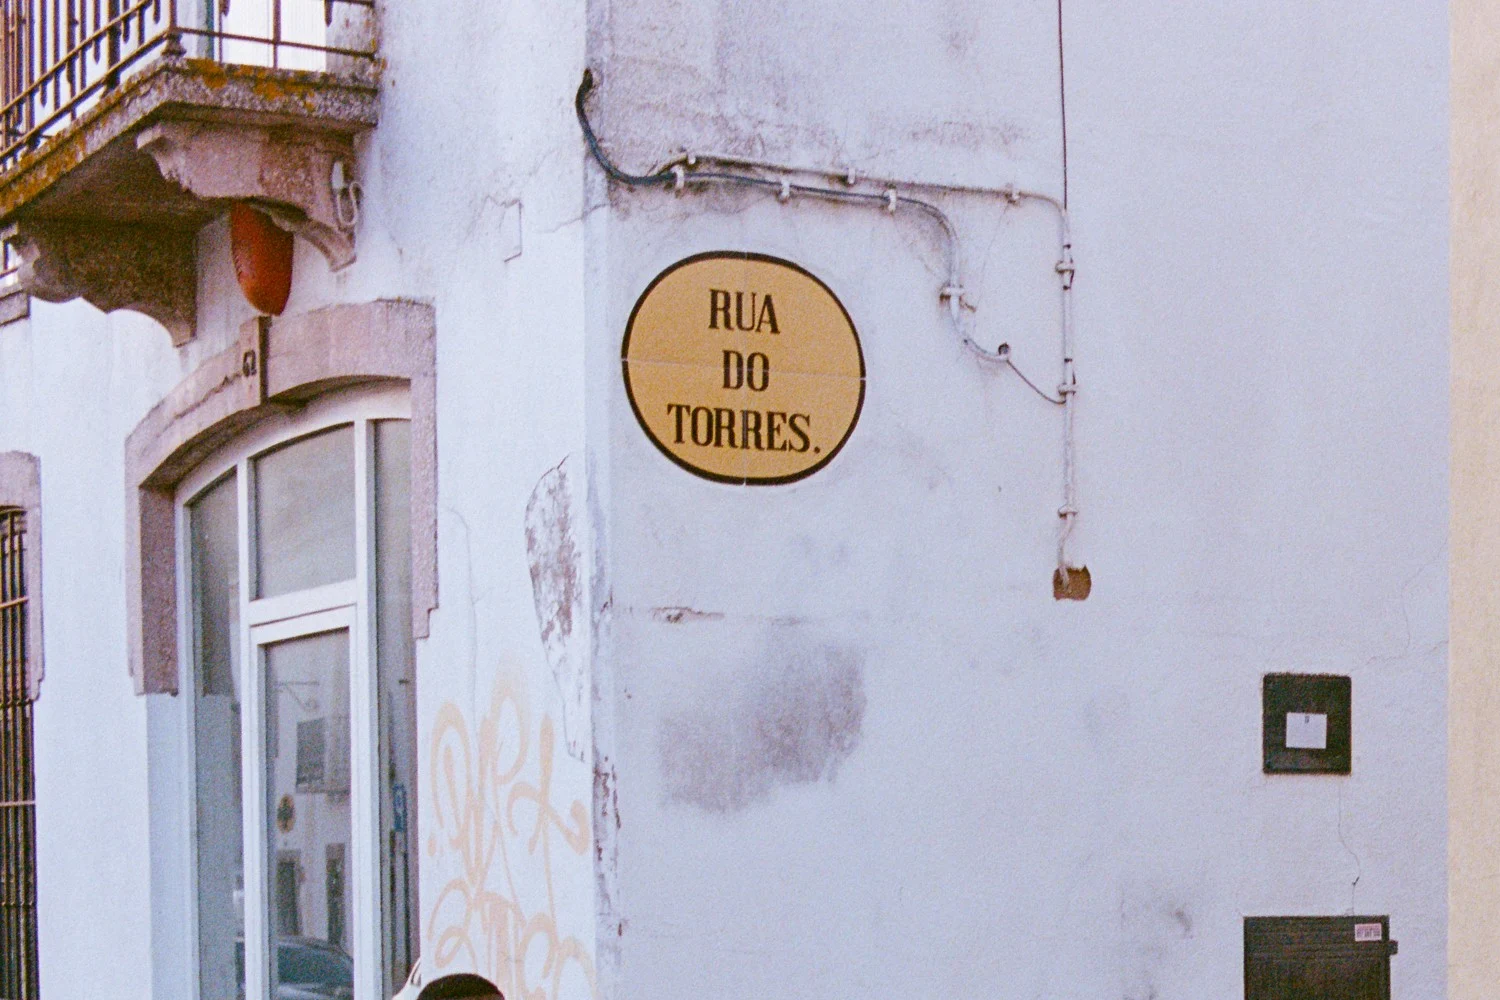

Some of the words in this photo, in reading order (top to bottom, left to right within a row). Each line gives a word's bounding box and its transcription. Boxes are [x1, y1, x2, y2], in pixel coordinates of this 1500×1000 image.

[708, 288, 780, 334] RUA
[722, 350, 769, 392] DO
[667, 403, 821, 454] TORRES.
